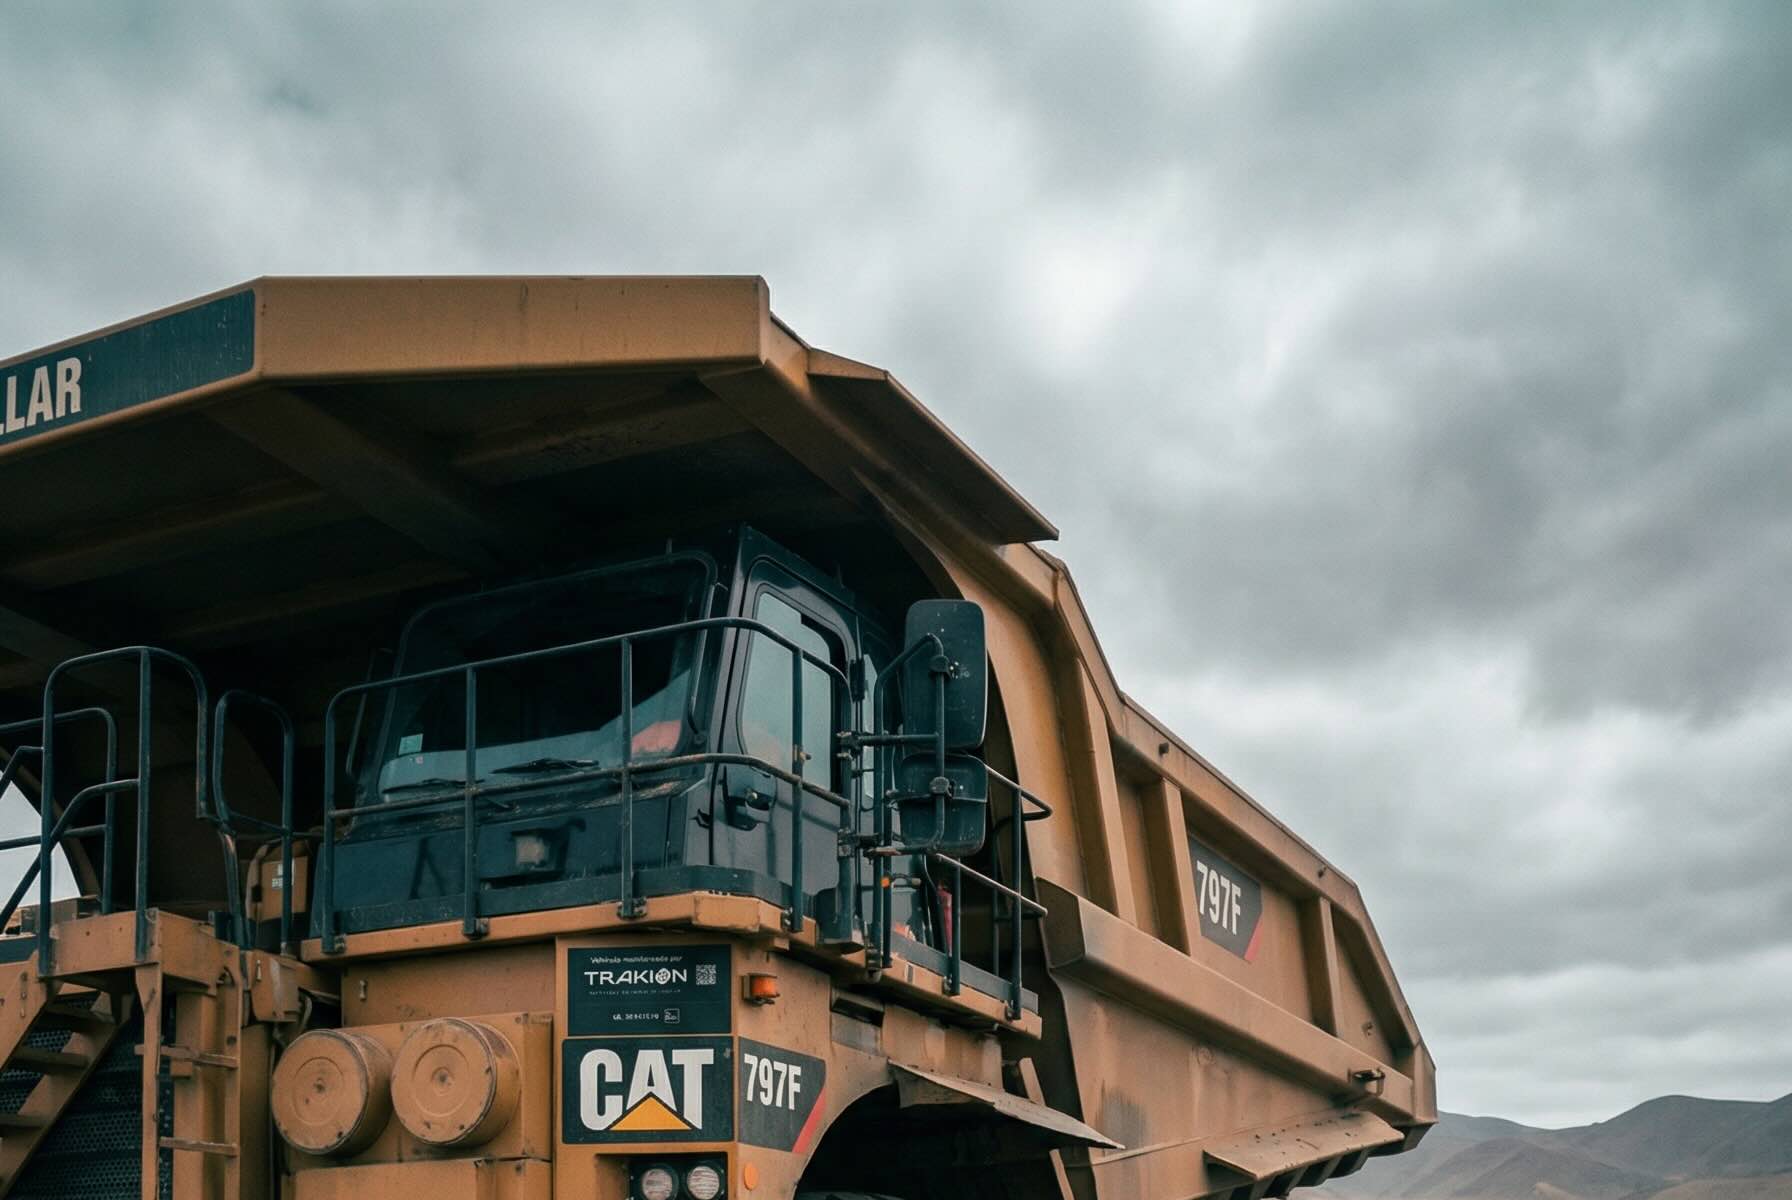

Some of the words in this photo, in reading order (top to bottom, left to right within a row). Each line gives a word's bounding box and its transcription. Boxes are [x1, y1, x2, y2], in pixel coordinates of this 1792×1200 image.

[1196, 859, 1242, 936] 797F
[584, 967, 688, 986] TRAKION
[579, 1048, 714, 1131] CAT
[743, 1053, 801, 1111] 797F
